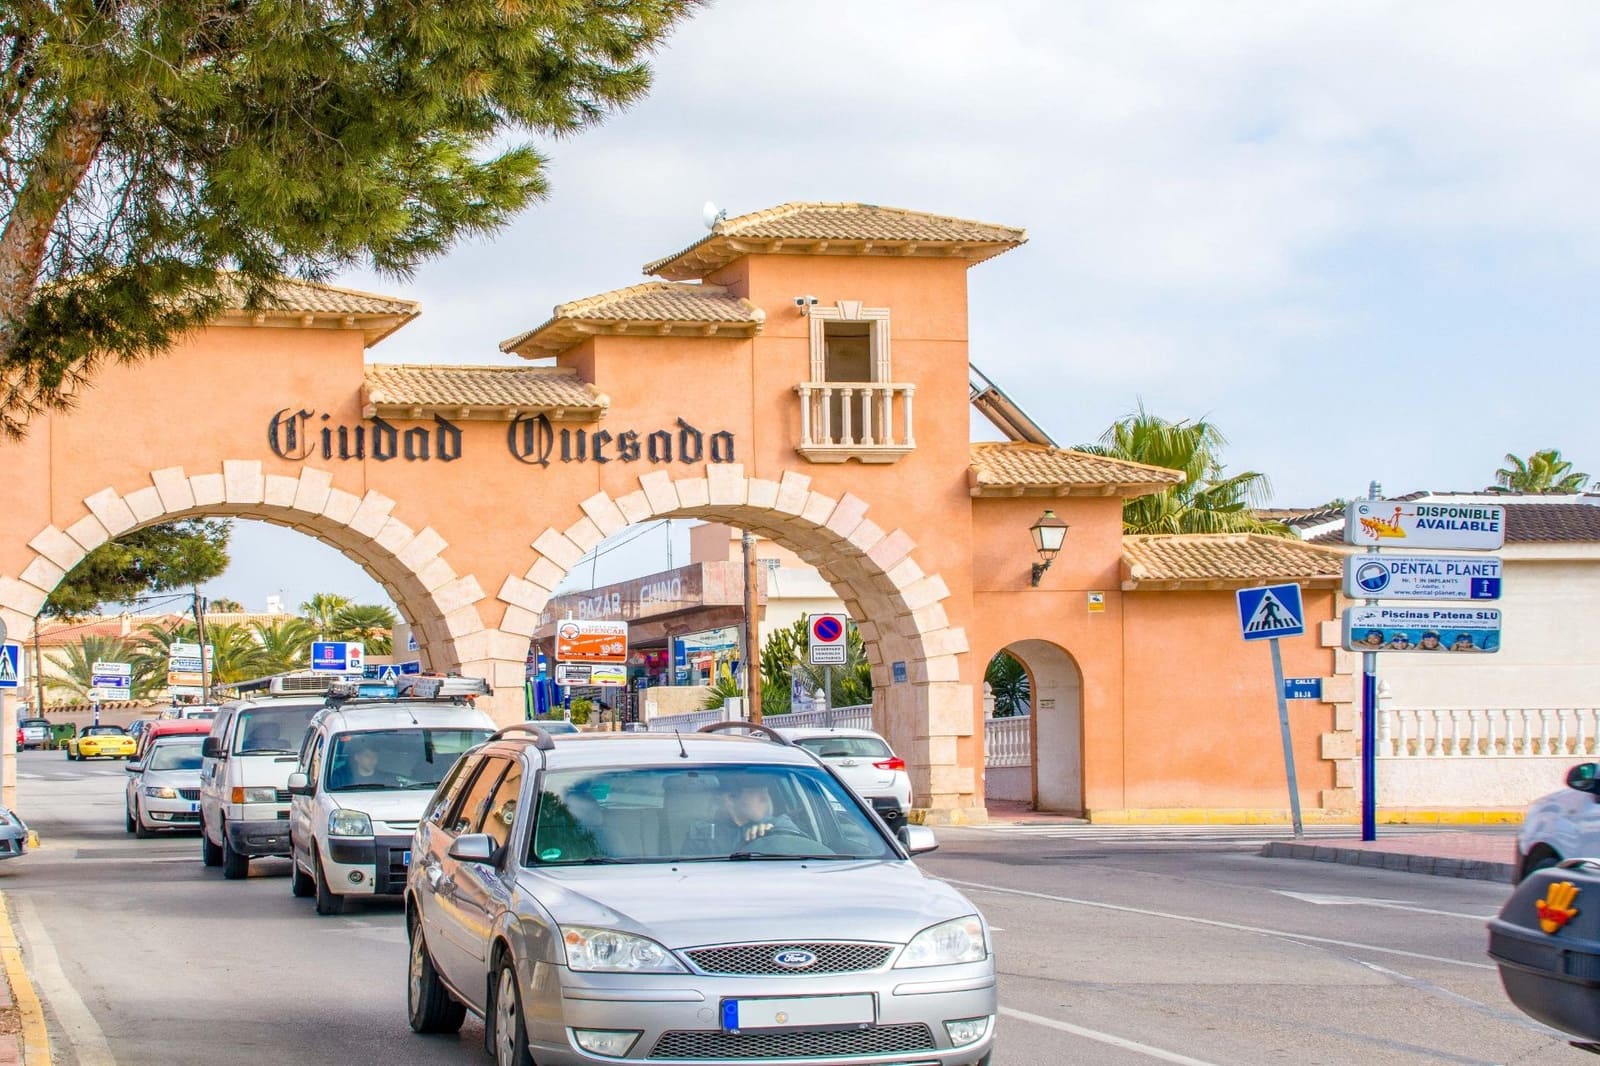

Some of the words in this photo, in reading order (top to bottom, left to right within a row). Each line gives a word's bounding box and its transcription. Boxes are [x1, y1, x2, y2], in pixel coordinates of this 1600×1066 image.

[268, 407, 462, 461] Ciudad
[508, 411, 736, 468] Quesada
[1416, 506, 1500, 520] DISPONIBLE
[1416, 519, 1499, 532] AVAILABLE
[1391, 562, 1442, 575] DENTAL
[1446, 563, 1499, 576] PLANET
[578, 592, 621, 620] BAZAR
[640, 577, 681, 605] CHINO
[1381, 610, 1429, 619] Piscinas
[1433, 611, 1473, 619] Patena
[1476, 611, 1498, 620] SLU
[783, 953, 806, 962] Ford
